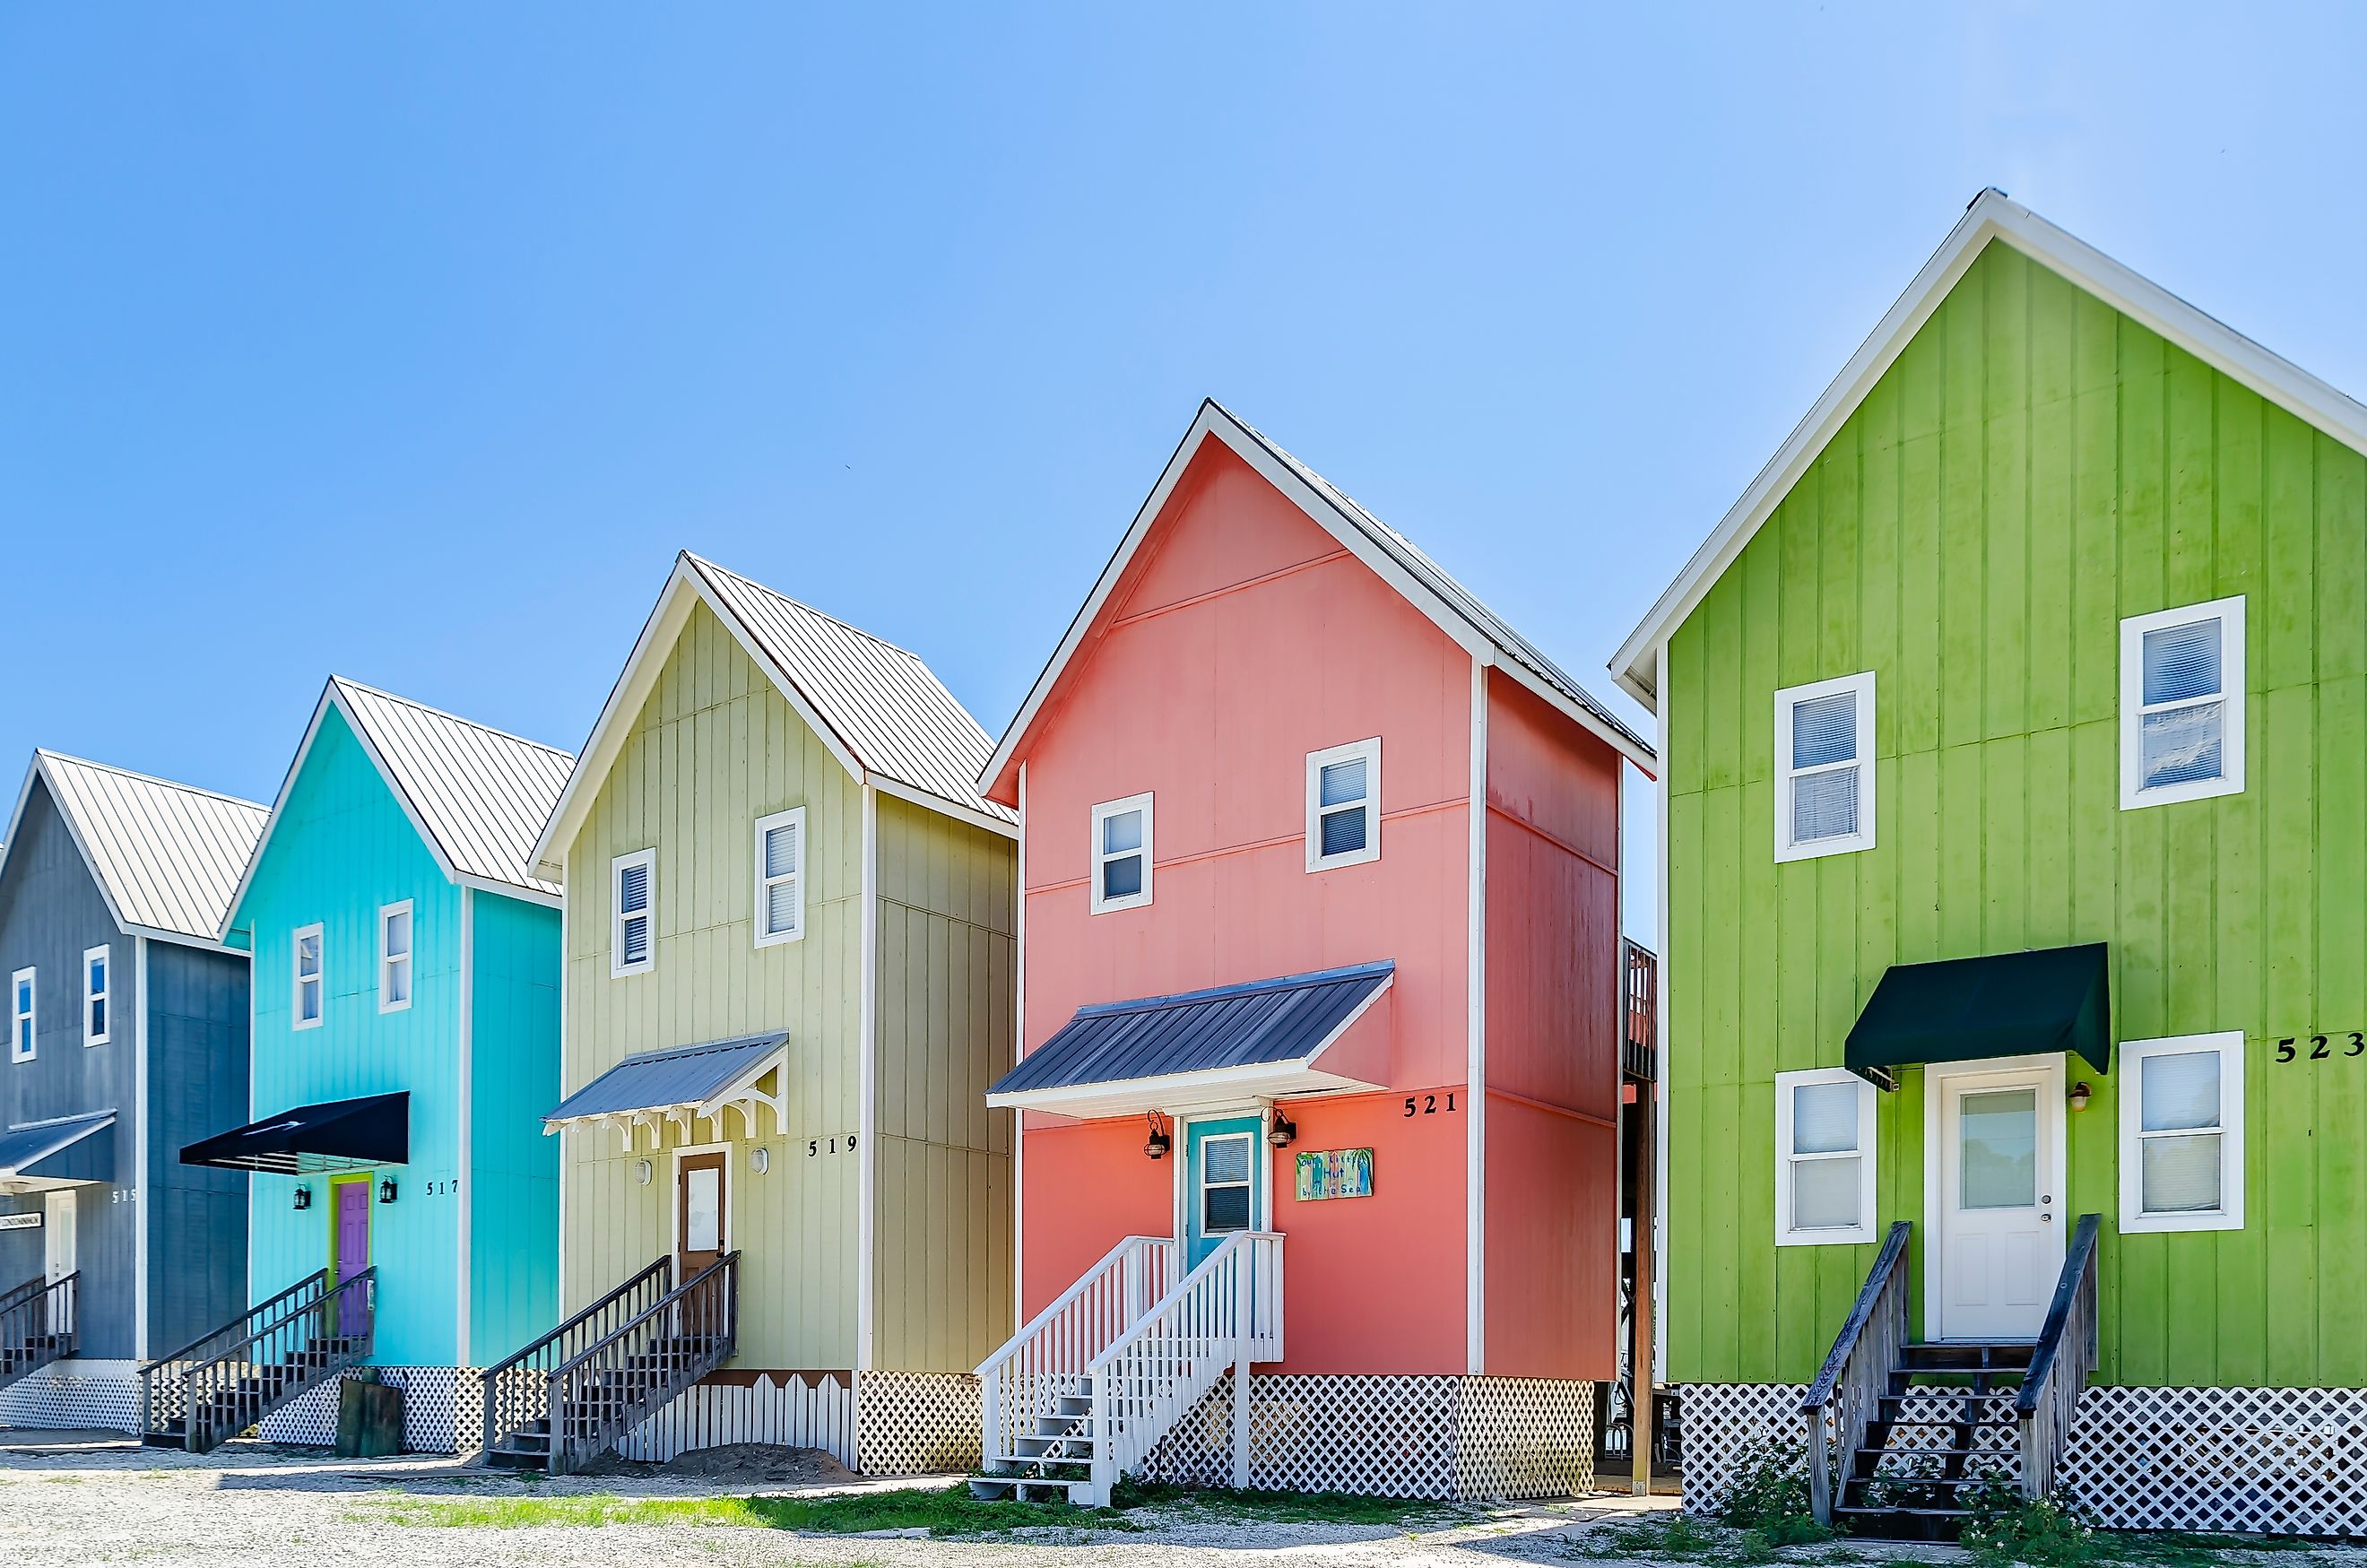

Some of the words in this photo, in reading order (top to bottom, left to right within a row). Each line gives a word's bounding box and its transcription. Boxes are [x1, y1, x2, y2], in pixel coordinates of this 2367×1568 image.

[2276, 1033, 2365, 1063] 523
[1403, 1093, 1456, 1118] 521
[808, 1135, 857, 1157] 519
[426, 1179, 459, 1196] 517
[1340, 1183, 1361, 1195] Sea
